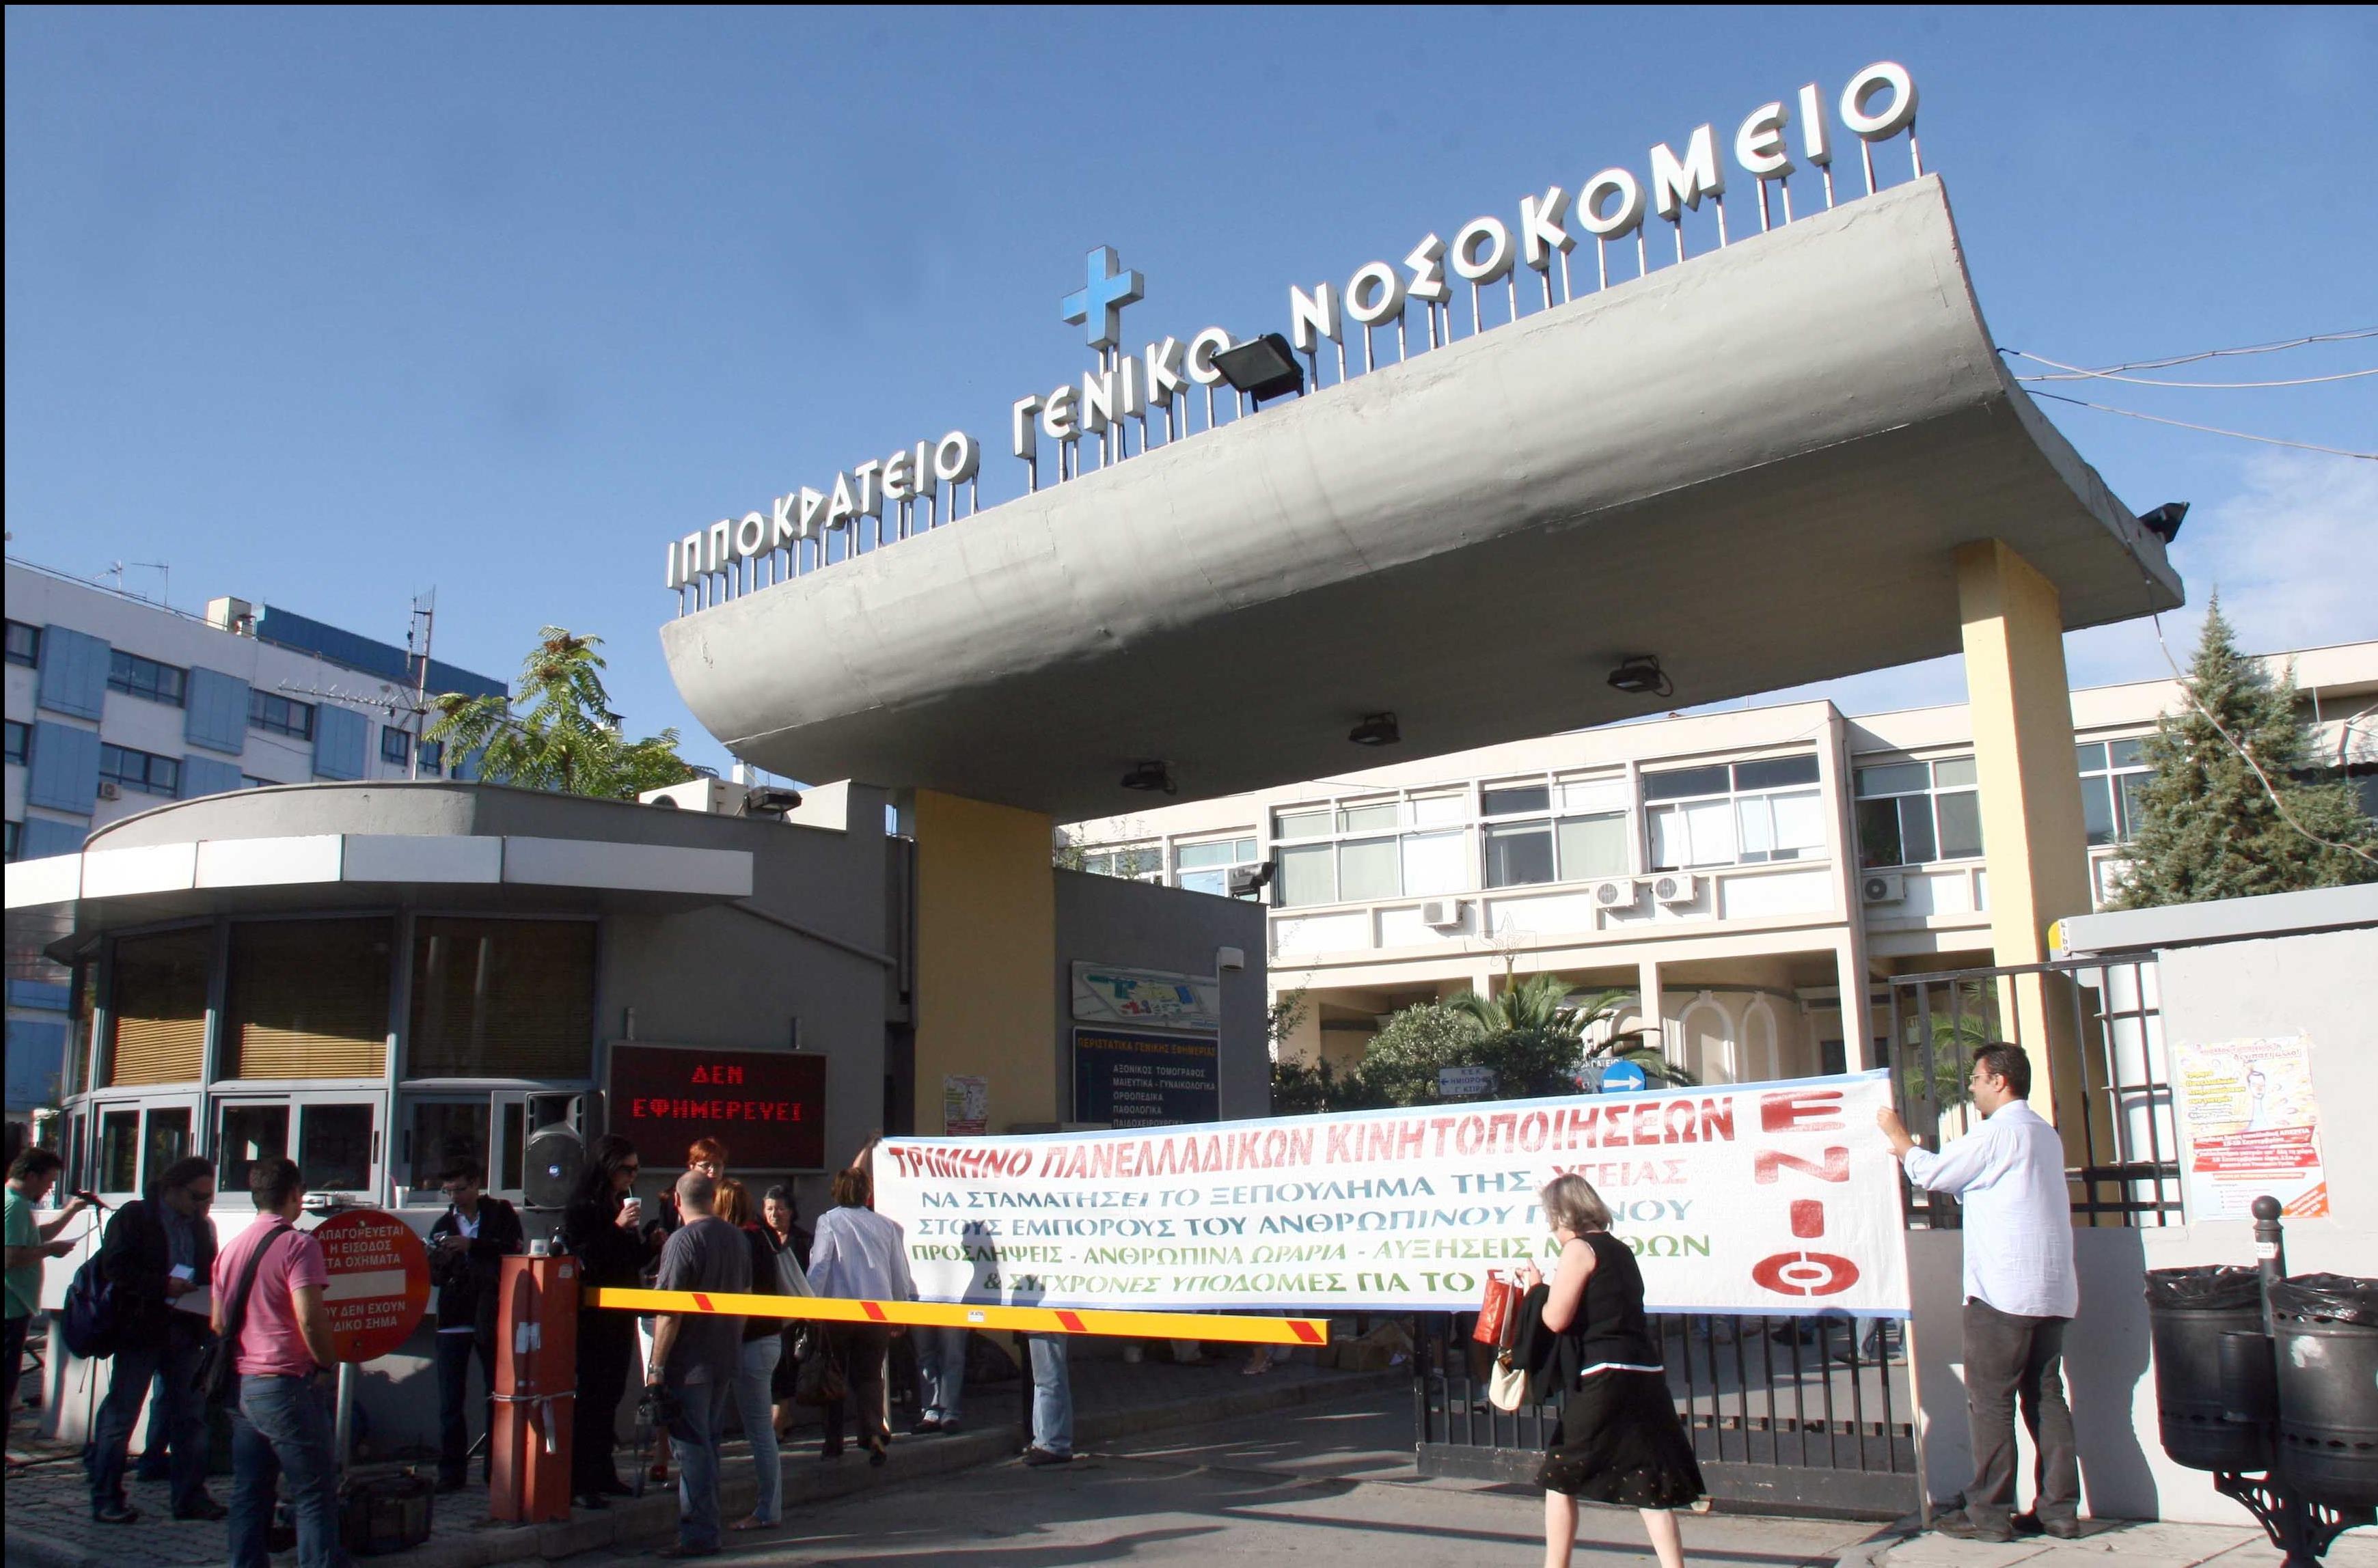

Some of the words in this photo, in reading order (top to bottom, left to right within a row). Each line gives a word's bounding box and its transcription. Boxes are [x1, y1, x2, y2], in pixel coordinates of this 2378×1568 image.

[667, 430, 977, 590] ΙΠΠΟΚΡΑΤΕΙΟ
[1013, 327, 1235, 459] ΓΕΝΙΚΟ
[1291, 61, 1918, 355] ΝΟΣΟΚΟΜΕΙΟ
[692, 1065, 743, 1084] ΔΕΝ
[1113, 1064, 1152, 1075] ΑΞΟΝΙΚΟΣ
[1157, 1067, 1205, 1077] ΤΟΜΟΓΡΑΦΟΣ
[1113, 1077, 1153, 1088] ΜΑΙΕΥΤΙΚΑ
[1160, 1079, 1216, 1090] ΓΥΝΑΙΚΟΛΟΓΙΚΑ
[1113, 1092, 1163, 1101] ΟΡΘΟΠΕΔΙΚΑ
[633, 1099, 802, 1120] ΕΦΗΜΕΡΕΥΕΙ
[1113, 1105, 1162, 1115] ΠΑΘΟΛΟΓΙΚΑ
[889, 1146, 1033, 1178] ΤΡΙΜΗΝΟ
[1040, 1128, 1313, 1179] ΠΑΝΕΛΛΑΔΙΚΩΝ
[1326, 1097, 1734, 1164] ΚΙΝΗΤΟΠΟΙΗΣΕΩΝ
[922, 1192, 959, 1207] ΝΑ
[968, 1192, 1149, 1207] ΣΤΑΜΑΤΗΣΕΙ
[1160, 1189, 1200, 1207] ΤΟ
[1210, 1177, 1435, 1205] ΞΕΠΟΥΛΗΜΑ
[1451, 1170, 1533, 1194] ΤΗΣ
[918, 1218, 1002, 1236] ΣΤΟΥΣ
[1013, 1218, 1175, 1237] ΕΜΠΟΡΟΥΣ
[1184, 1216, 1246, 1235] ΤΟΥ
[1259, 1205, 1514, 1235] ΑΝΘΡΩΠΙΝΟΥ
[318, 1226, 404, 1240] ΑΠΑΓΟΡΕΥΕΤΑΙ
[330, 1243, 338, 1254] Η
[343, 1240, 392, 1252] ΕΙΣΟΔΟΣ
[912, 1246, 1063, 1263] ΠΡΟΣΛΗΨΕΙΣ
[1084, 1246, 1244, 1265] ΑΝΘΡΩΠΙΝΑ
[1250, 1241, 1345, 1263] ΩΡΑΡΙΑ
[1373, 1237, 1533, 1258] ΑΥΞΗΣΕΙΣ
[323, 1258, 341, 1268] ΤΑ
[346, 1254, 400, 1267] ΟΧΗΜΑΤΑ
[983, 1273, 1001, 1289] &
[1007, 1274, 1161, 1293] ΣΥΓΧΡΟΝΕΣ
[1173, 1274, 1347, 1293] ΥΠΟΔΟΜΕΣ
[1357, 1273, 1410, 1292] ΓΙΑ
[1420, 1273, 1475, 1292] ΤΟ
[342, 1305, 364, 1317] ΔΕΝ
[368, 1301, 406, 1315] ΕΧΟΥΝ
[366, 1317, 397, 1328] ΣΗΜΑ
